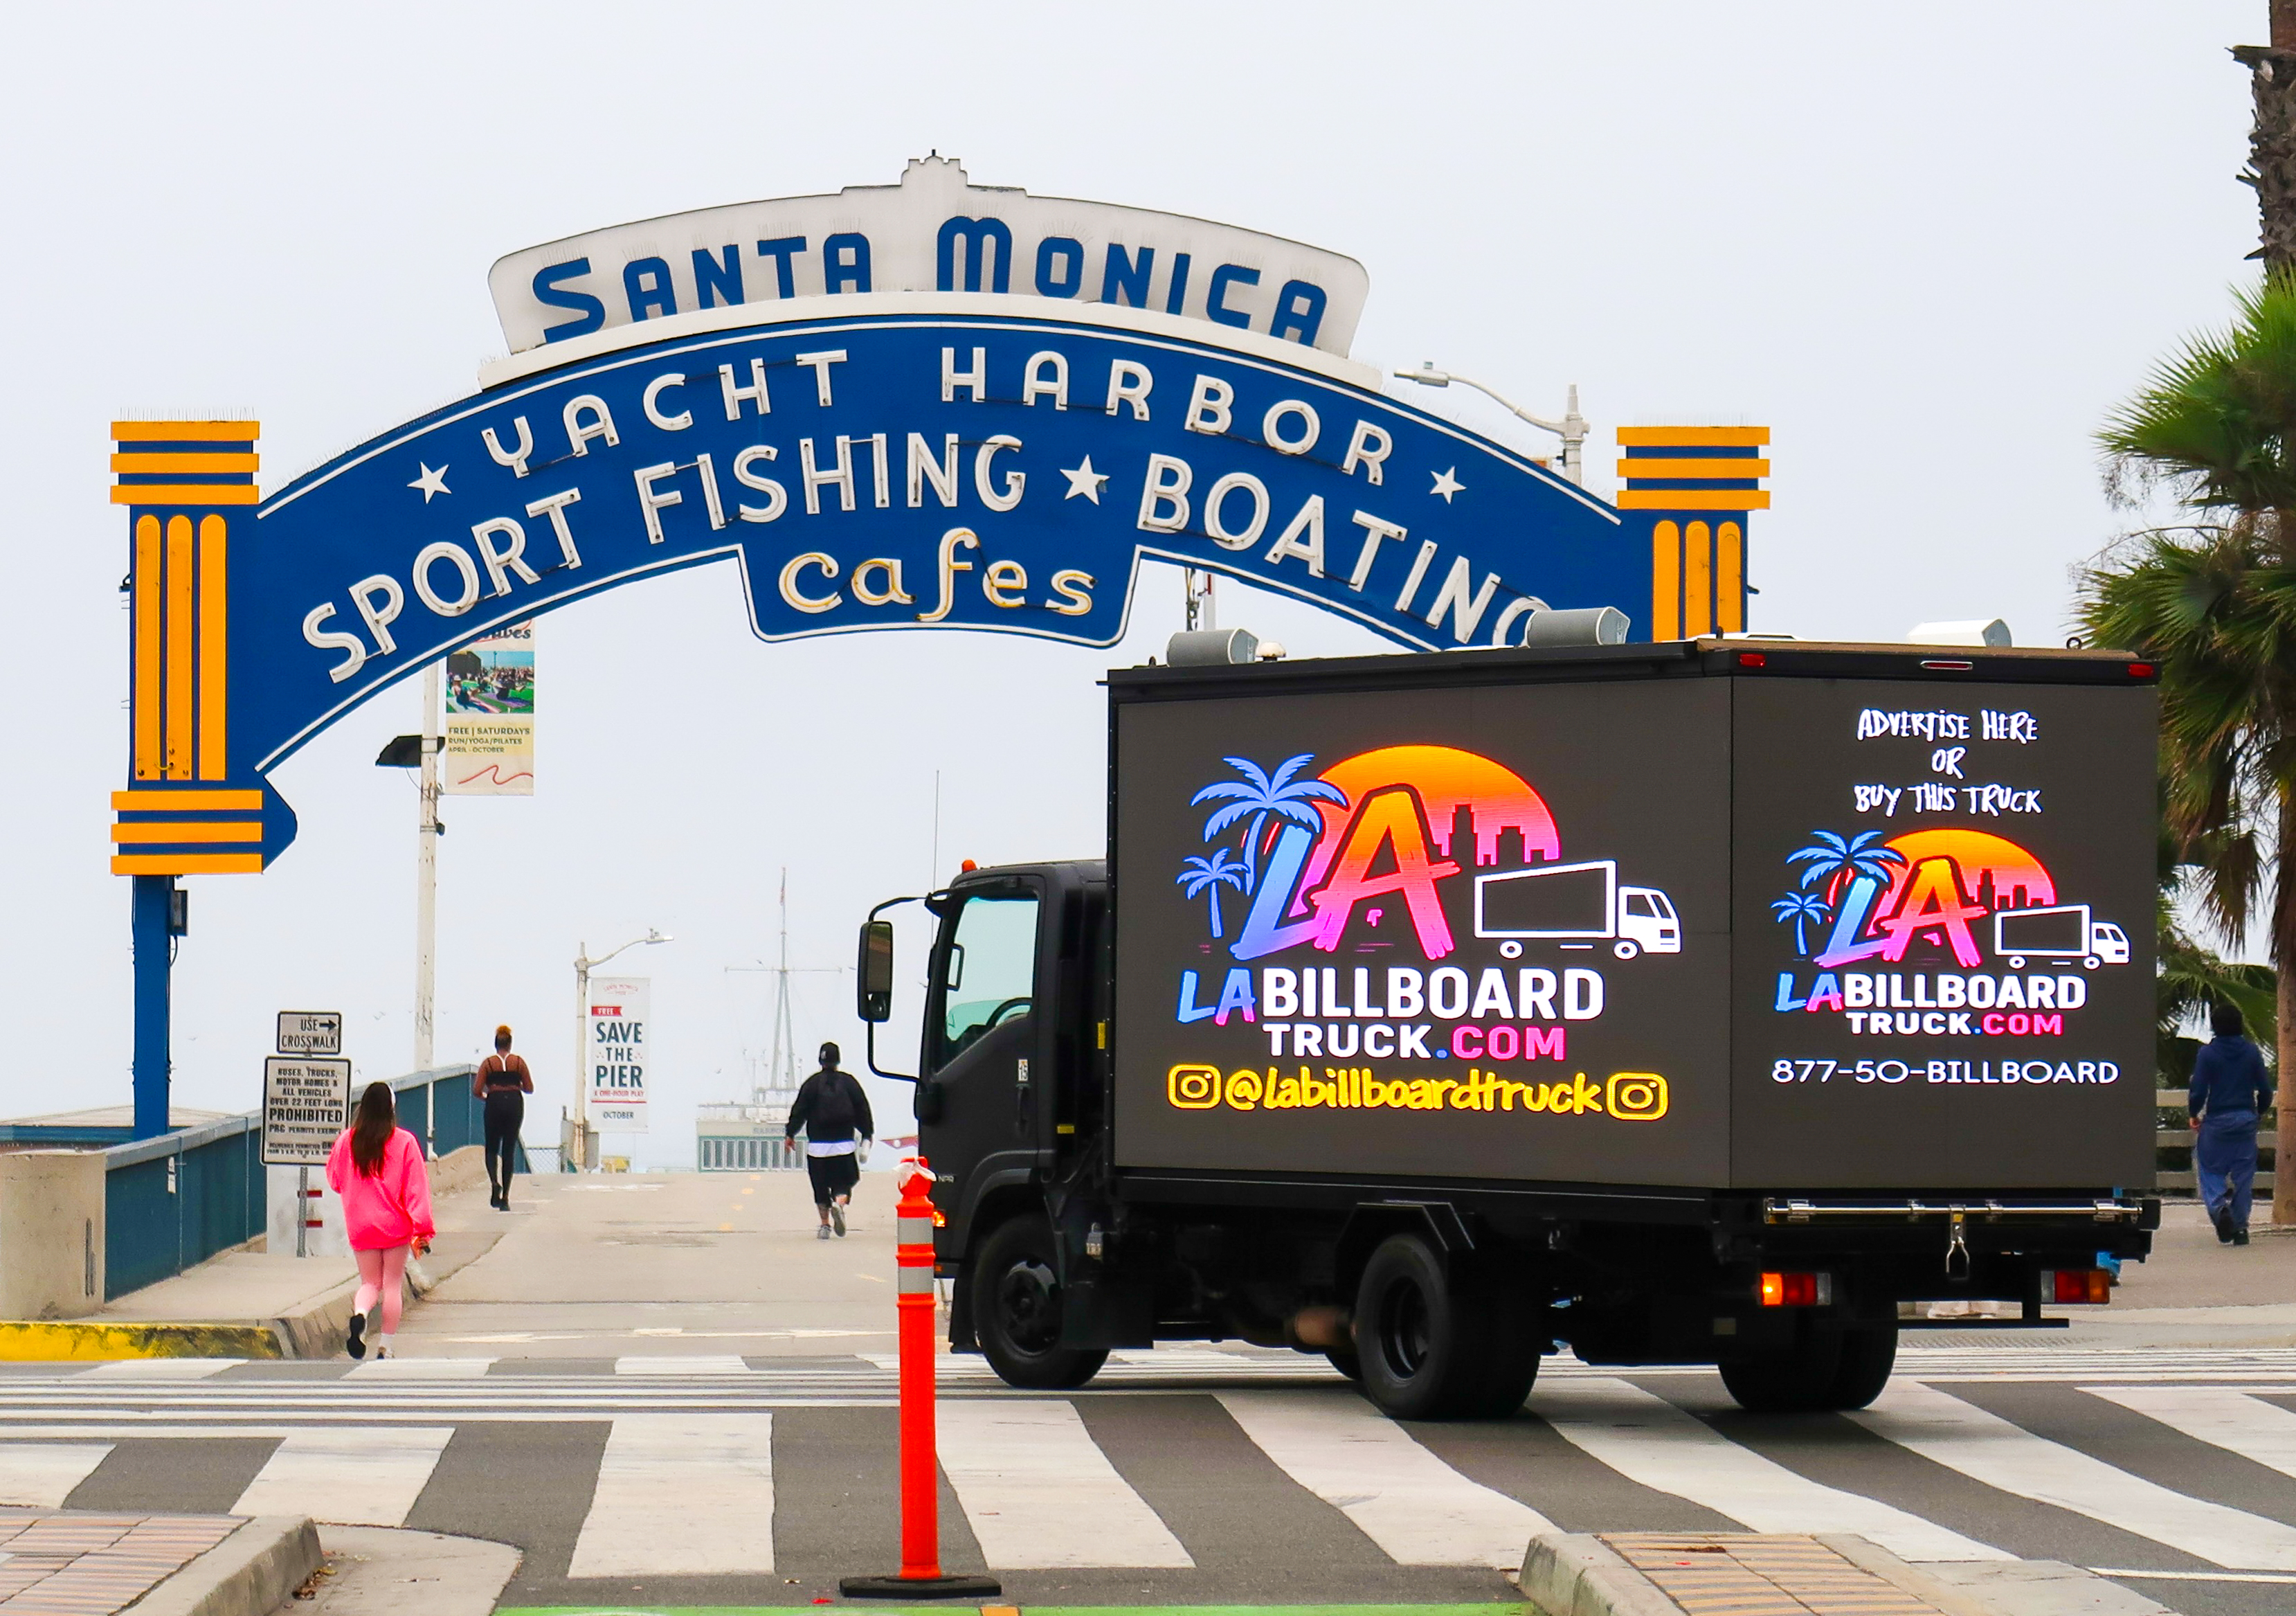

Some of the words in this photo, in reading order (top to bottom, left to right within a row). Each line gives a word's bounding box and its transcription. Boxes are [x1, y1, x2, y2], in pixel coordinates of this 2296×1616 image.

[532, 232, 871, 344] SANTA
[937, 215, 1327, 347] MONICA
[481, 350, 847, 478] YACHT
[941, 347, 1393, 486] HARBOR
[302, 487, 581, 683] SPORT
[634, 433, 1025, 545] FISHING
[779, 528, 1096, 622] cafes
[1857, 709, 1970, 741] ADVERTISE
[1982, 710, 2039, 744] HERE
[1931, 746, 1965, 779] OR
[1854, 784, 1901, 817] BUY
[1907, 783, 1956, 812] THIS
[1962, 784, 2041, 816] TRUCK
[1230, 788, 1461, 959] LA
[1814, 858, 1989, 968] LA
[300, 1019, 318, 1031] USE
[596, 1022, 642, 1043] SAVE
[1845, 1012, 2063, 1036] TRUCK.COM
[281, 1034, 336, 1048] CROSSWALK
[1262, 1024, 1566, 1061] TRUCK.COM
[606, 1047, 633, 1061] THE
[275, 1078, 301, 1086] MOTOR
[304, 1078, 329, 1087] HOMES
[278, 1068, 304, 1077] BUSES,
[307, 1068, 337, 1078] TRUCKS,
[596, 1066, 643, 1088] PIER
[1771, 1059, 2119, 1084] 877-50-BILLBOARD
[298, 1088, 332, 1097] VEHICLES
[305, 1098, 323, 1106] FEET
[1224, 1068, 1603, 1114] @labillboardtruck
[269, 1108, 343, 1122] PROHIBITED
[603, 1111, 635, 1119] OCTOBER
